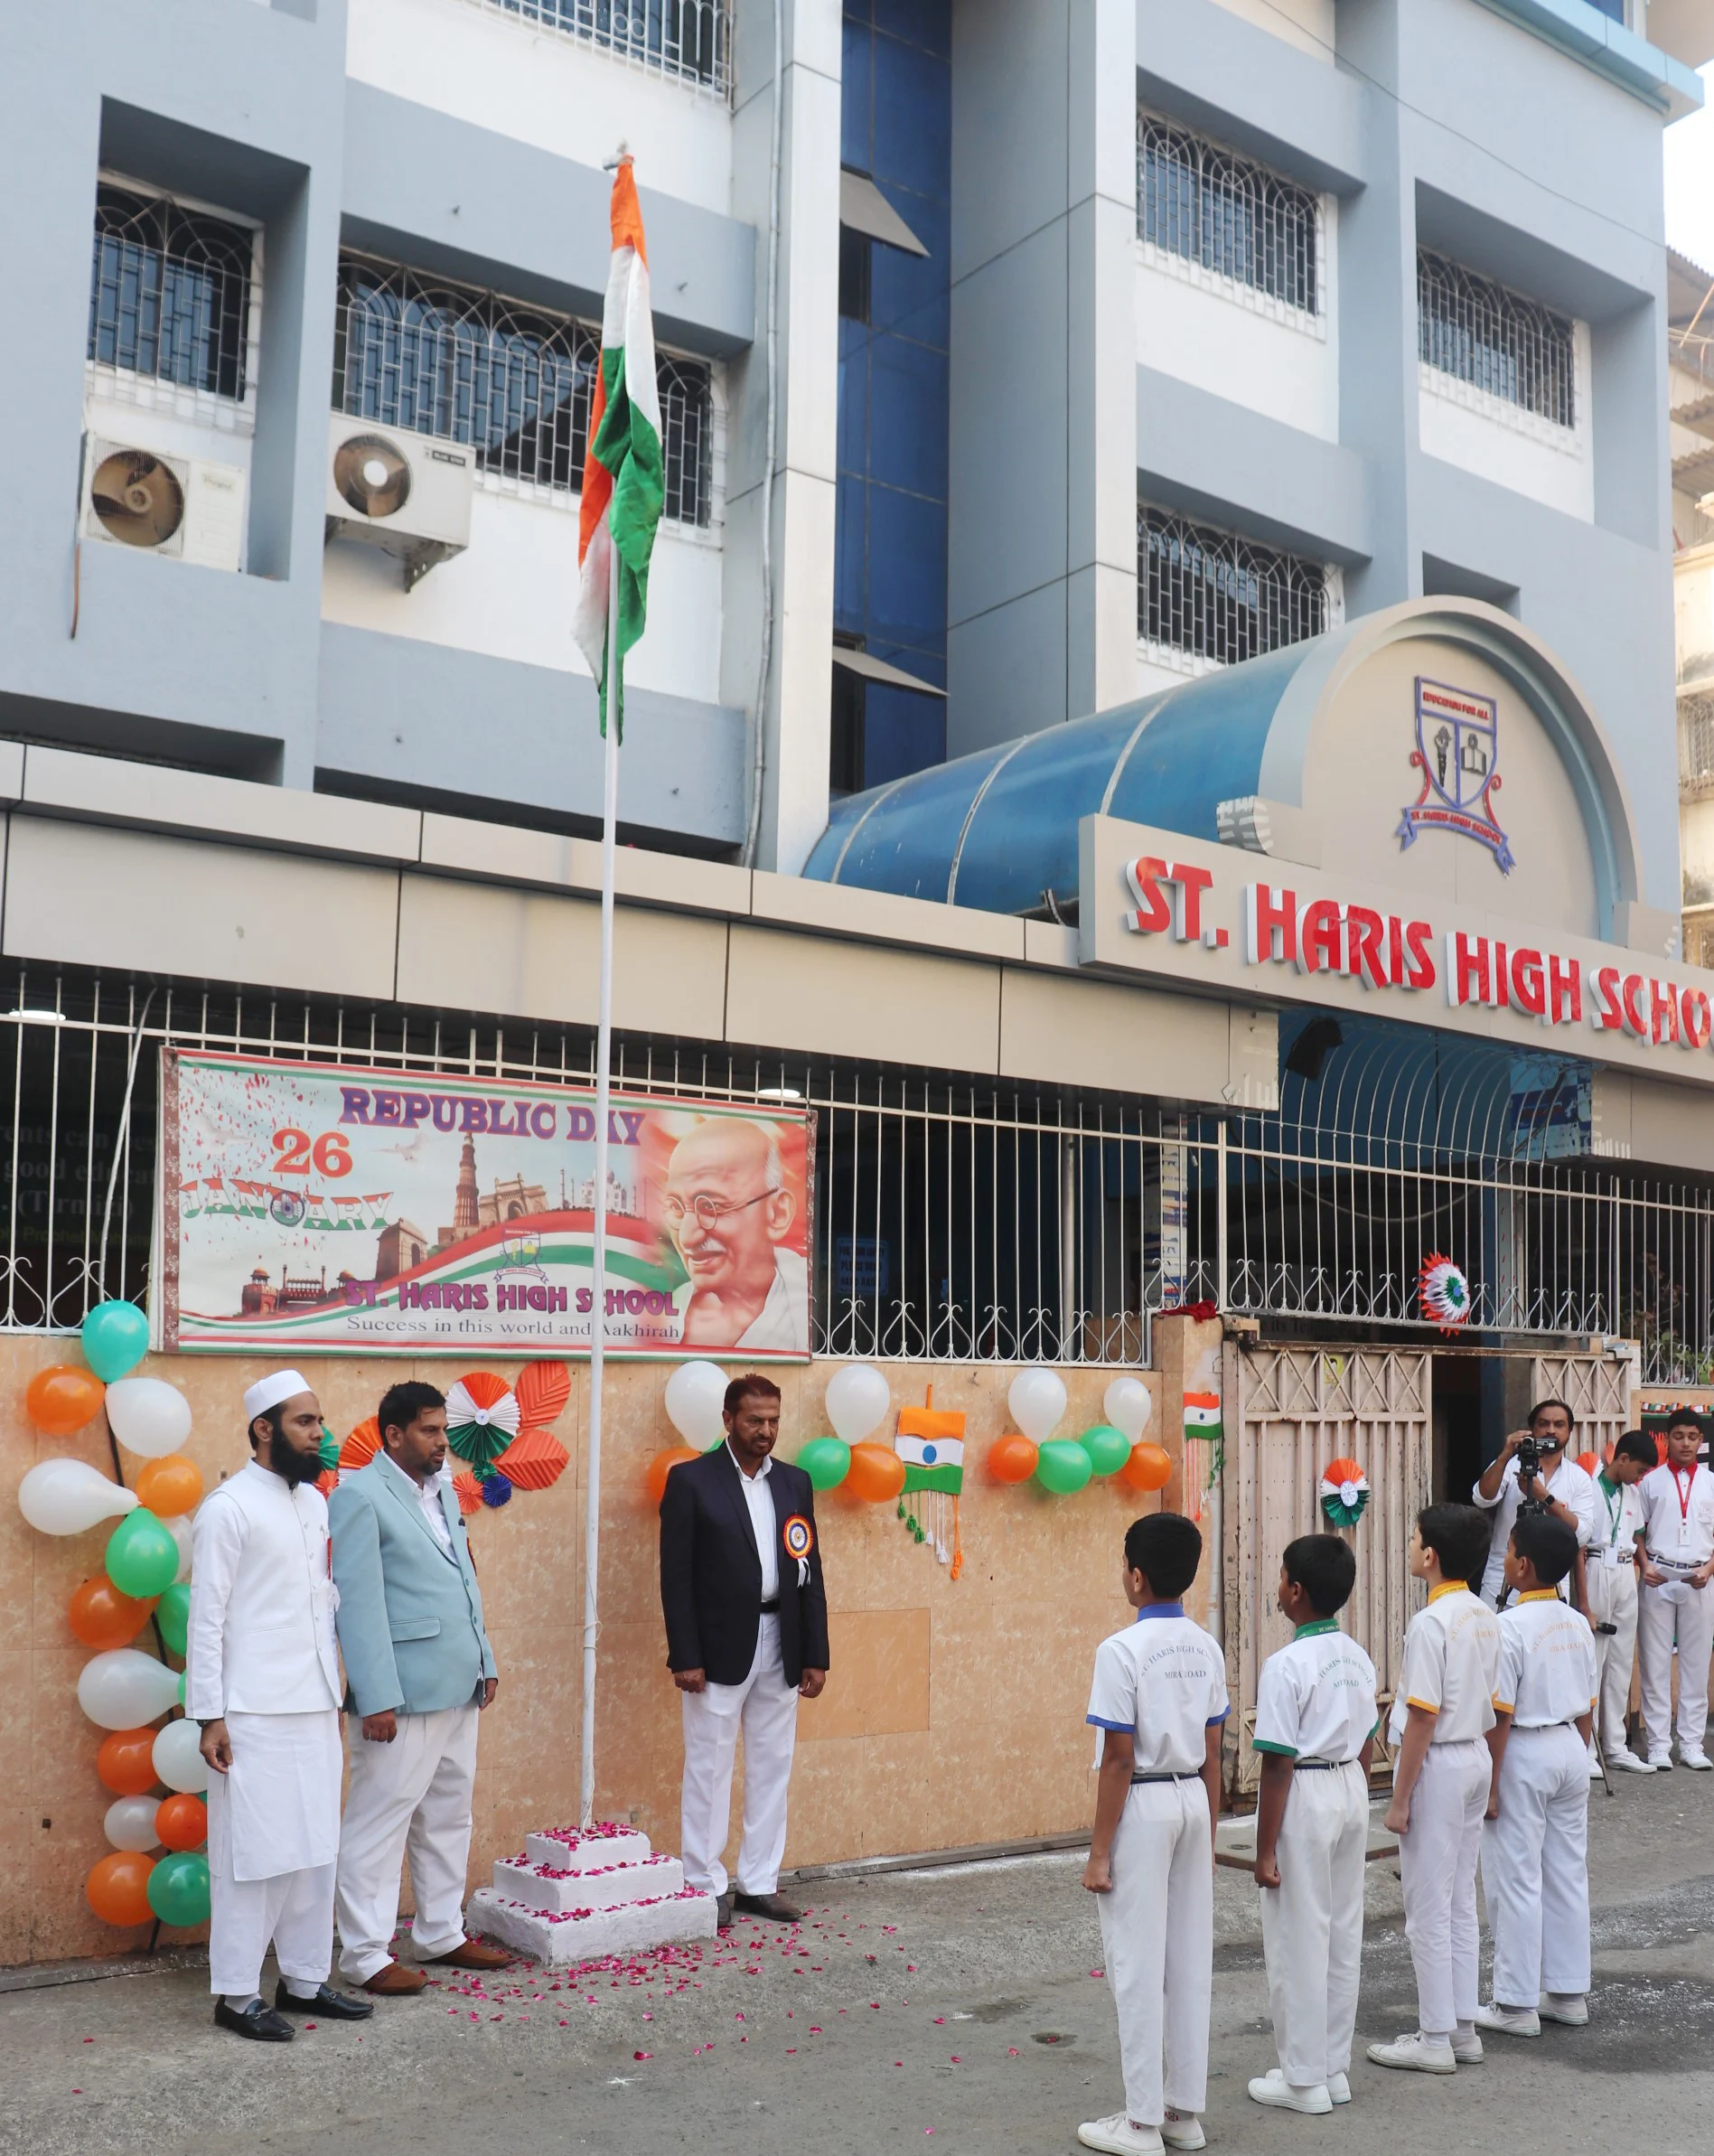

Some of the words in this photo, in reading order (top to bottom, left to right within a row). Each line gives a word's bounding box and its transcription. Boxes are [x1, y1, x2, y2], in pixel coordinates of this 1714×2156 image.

[1422, 691, 1461, 712] EDUCATION
[1462, 703, 1476, 716] FOR
[1477, 708, 1490, 720] ALL
[1449, 813, 1471, 829] HIGH
[1472, 820, 1502, 844] SCHOOL
[1127, 856, 1229, 950] ST.
[1247, 883, 1437, 990] HARIS
[1447, 932, 1581, 1026] HIGH
[1589, 967, 1714, 1049] SCHO
[338, 1087, 557, 1140] REPUBLIC
[272, 1128, 353, 1178] 26
[345, 1280, 389, 1308] ST.
[398, 1282, 489, 1312] HARIS
[497, 1284, 567, 1314] HIGH
[347, 1316, 427, 1332] Success
[435, 1318, 452, 1333] in
[459, 1319, 492, 1333] this
[501, 1321, 552, 1335] world
[559, 1322, 591, 1336] and
[1148, 1645, 1175, 1664] HARIS
